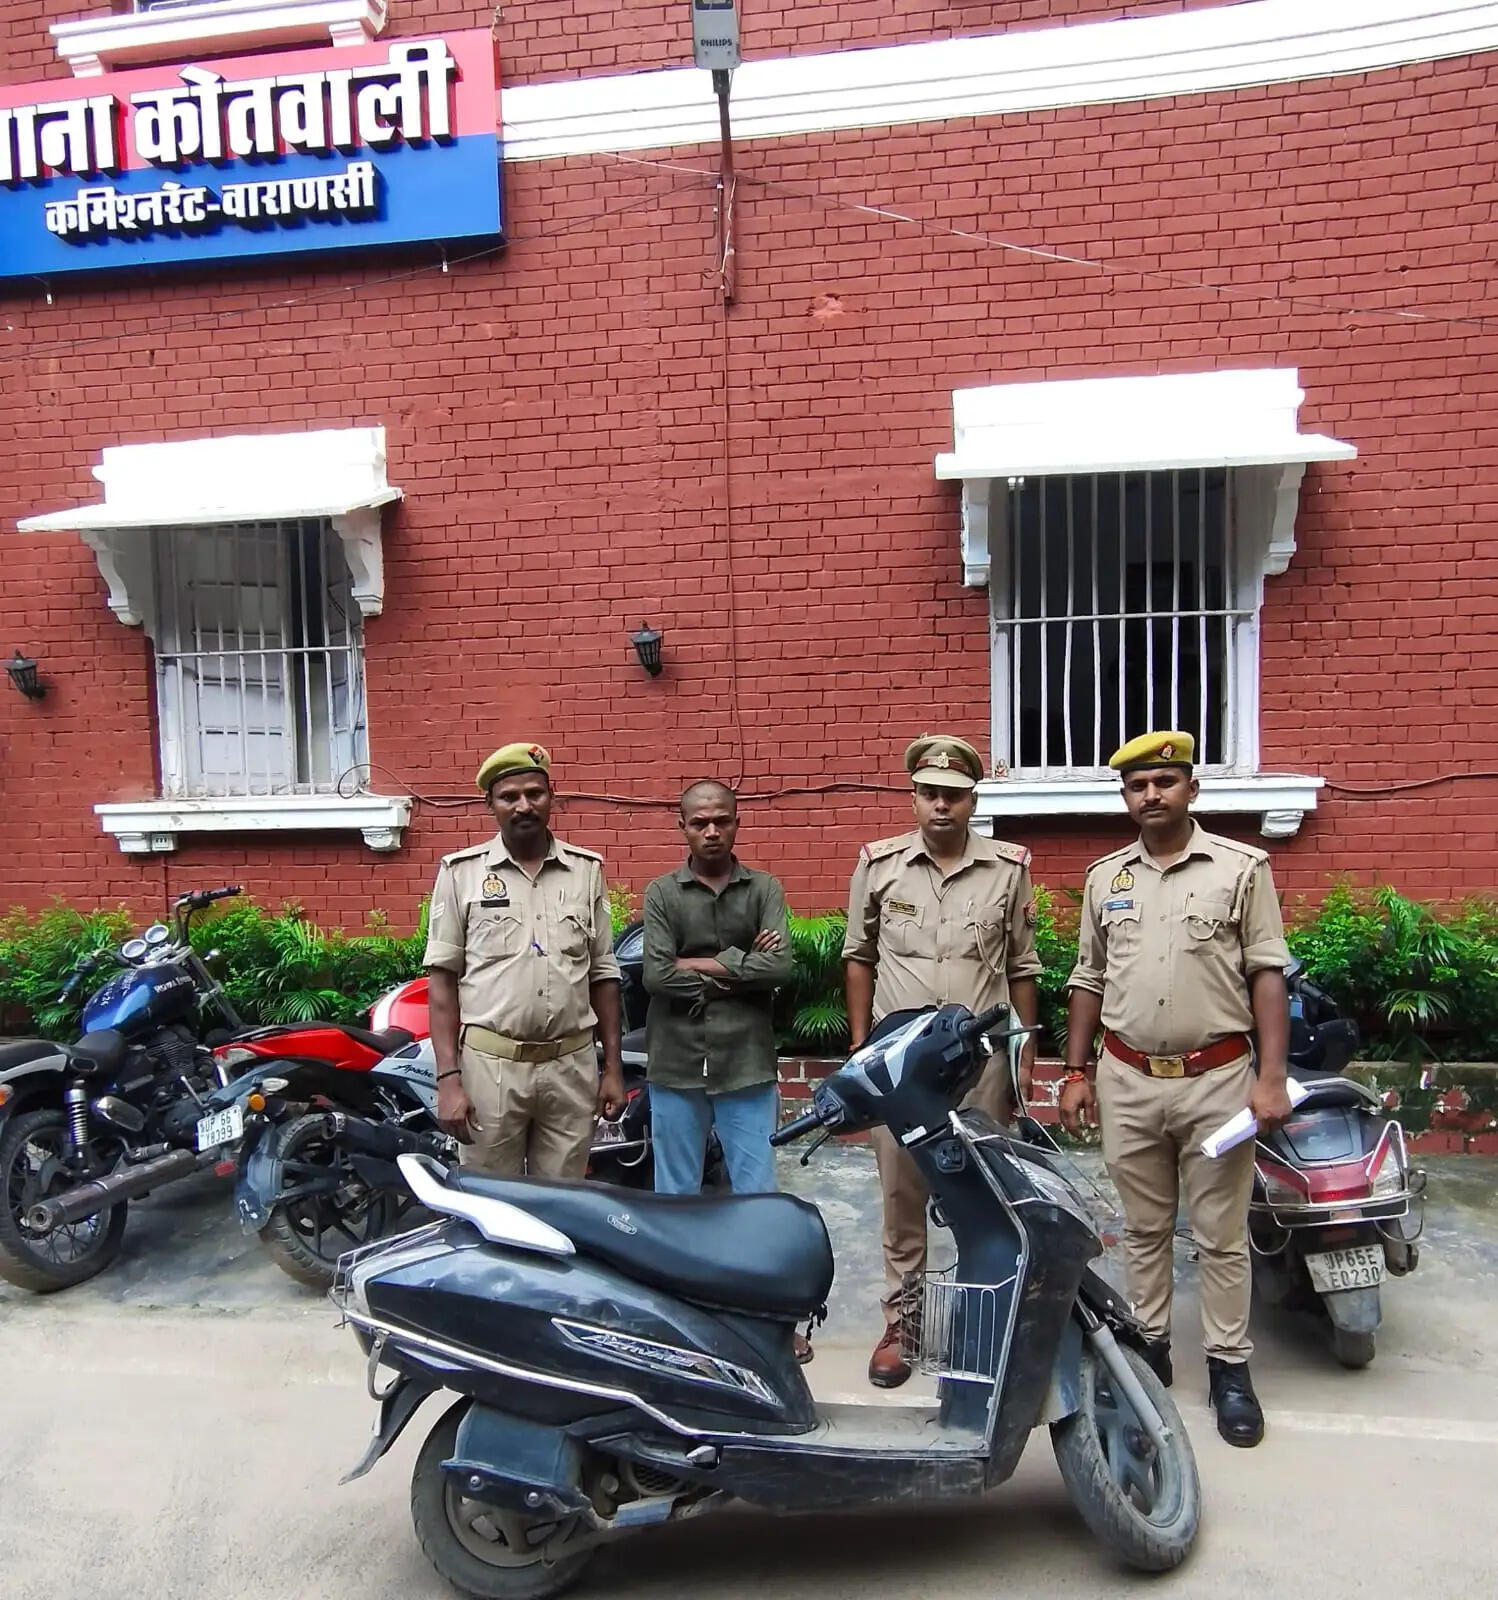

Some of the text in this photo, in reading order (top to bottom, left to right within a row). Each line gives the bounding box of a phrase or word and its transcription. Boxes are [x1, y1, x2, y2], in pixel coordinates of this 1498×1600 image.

[700, 38, 733, 47] PHILIPS
[0, 38, 456, 181] ाना कोतवाली
